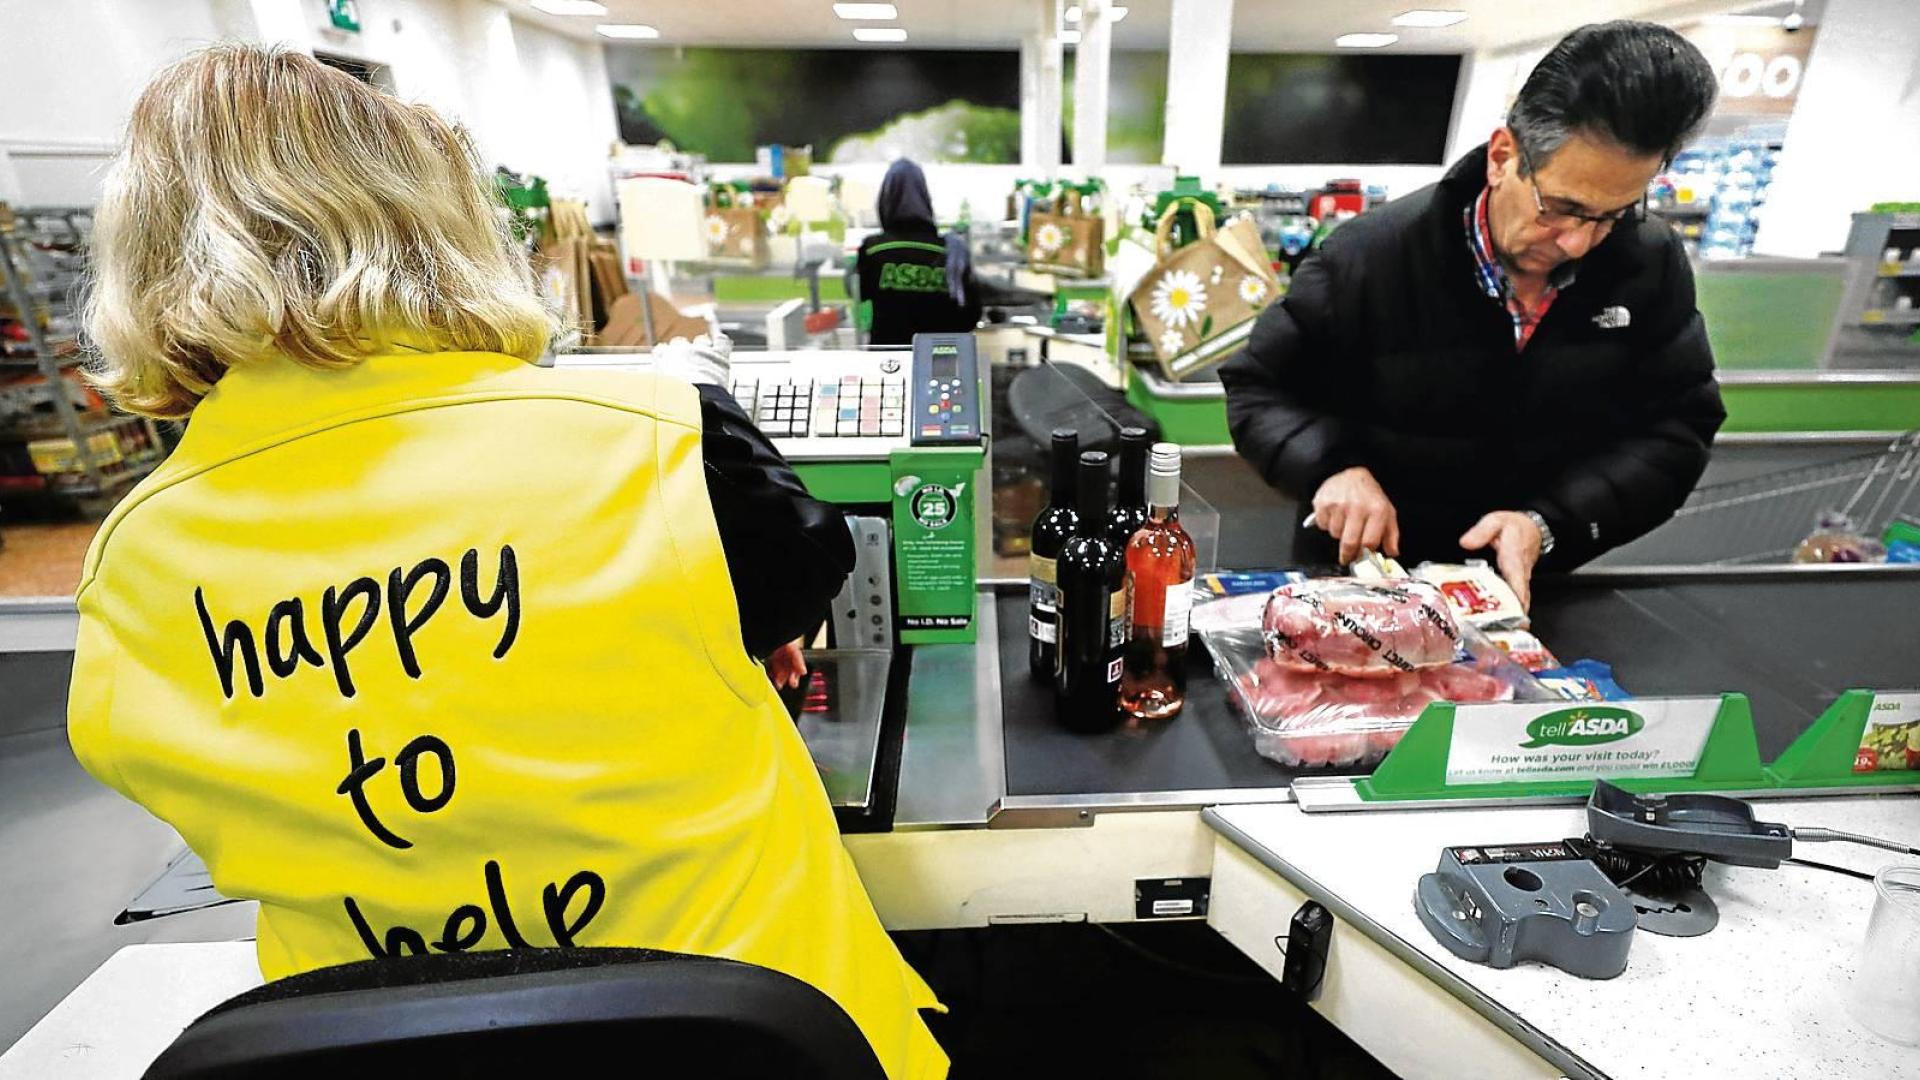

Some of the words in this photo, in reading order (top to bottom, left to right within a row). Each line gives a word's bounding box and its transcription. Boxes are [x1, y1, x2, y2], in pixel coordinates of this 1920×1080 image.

[922, 502, 946, 517] 25
[194, 543, 523, 699] happy
[1490, 754, 1520, 764] How
[1523, 753, 1549, 763] was
[1552, 752, 1582, 763] your
[1584, 750, 1612, 761] visit
[1615, 748, 1661, 761] today?
[1540, 721, 1567, 737] tell
[1566, 717, 1629, 736] ASDA
[336, 728, 456, 849] to
[344, 859, 606, 959] help
